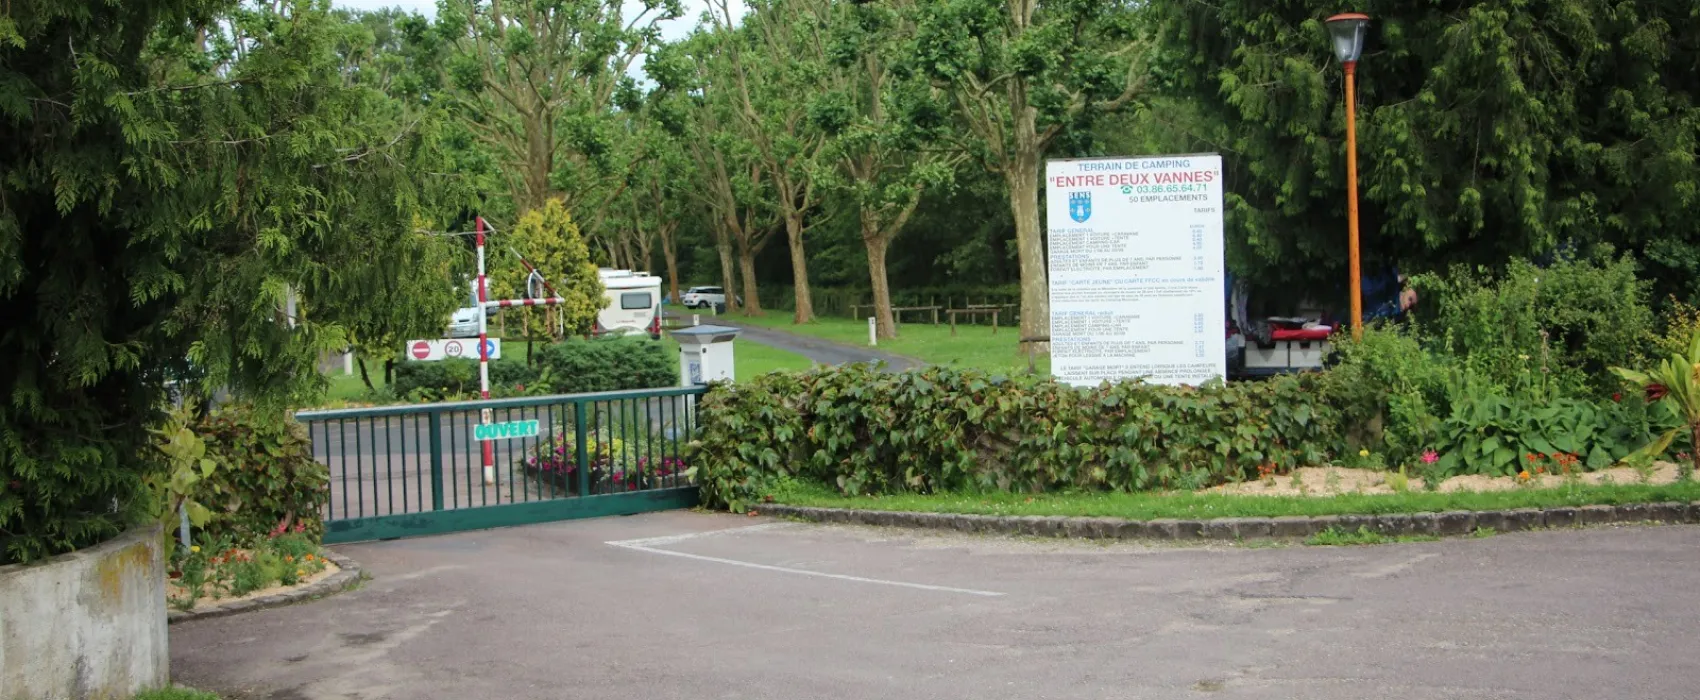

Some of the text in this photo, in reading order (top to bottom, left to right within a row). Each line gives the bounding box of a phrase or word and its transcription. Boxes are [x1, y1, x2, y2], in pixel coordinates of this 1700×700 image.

[1078, 160, 1190, 171] TERRAIN DE CAMPING
[1109, 172, 1150, 186] DEUX
[1136, 184, 1207, 194] 03.86.65.64.71
[1140, 194, 1208, 202] EMPLACEMENTS
[475, 421, 538, 439] OUVERT
